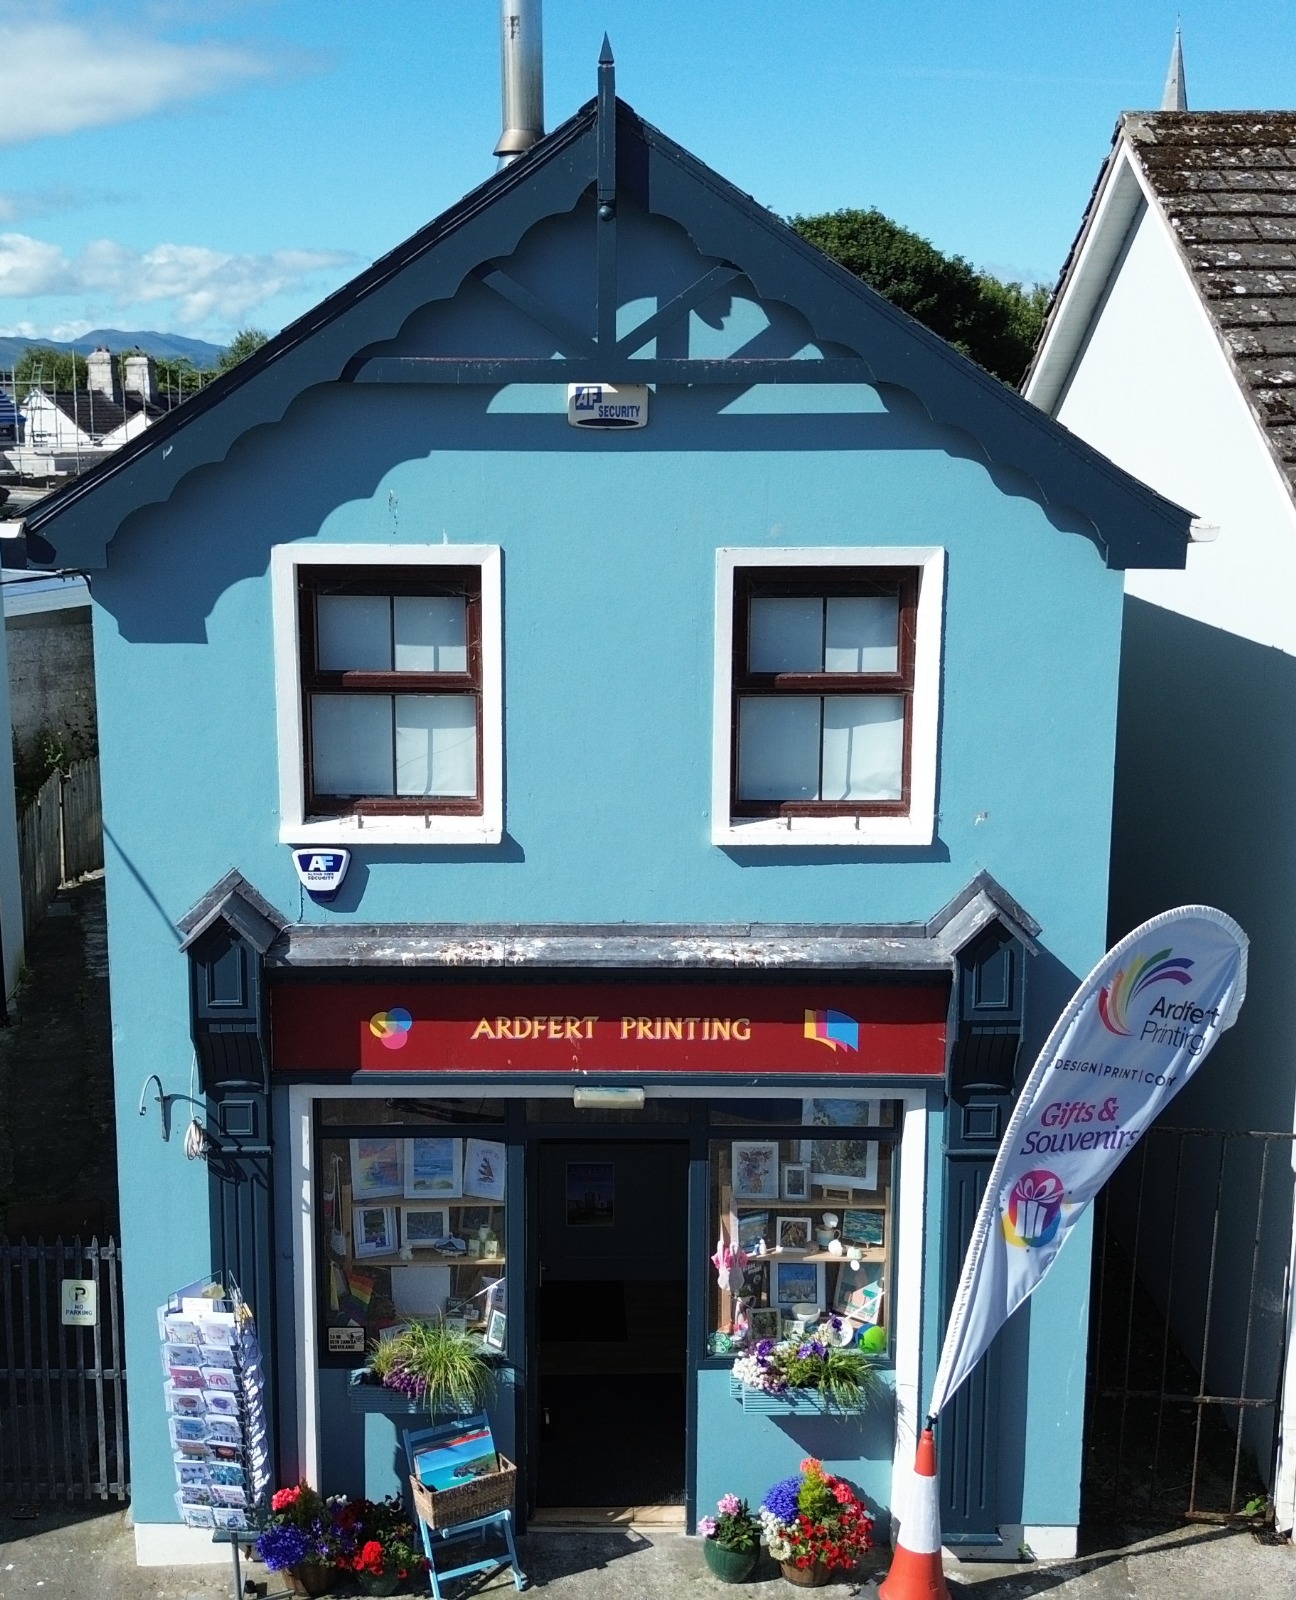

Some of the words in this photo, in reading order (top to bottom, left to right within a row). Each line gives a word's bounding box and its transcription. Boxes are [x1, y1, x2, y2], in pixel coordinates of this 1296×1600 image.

[576, 387, 599, 406] AF
[598, 405, 641, 418] SECURITY
[308, 855, 334, 871] AF
[470, 1015, 599, 1040] ARDFERT
[620, 1016, 751, 1041] PRINTING
[1055, 1059, 1097, 1074] DESIGN
[1103, 1065, 1138, 1081] PRINT
[1041, 1101, 1096, 1129] Gifts
[1097, 1097, 1120, 1122] &
[1020, 1125, 1139, 1156] Souvenirs
